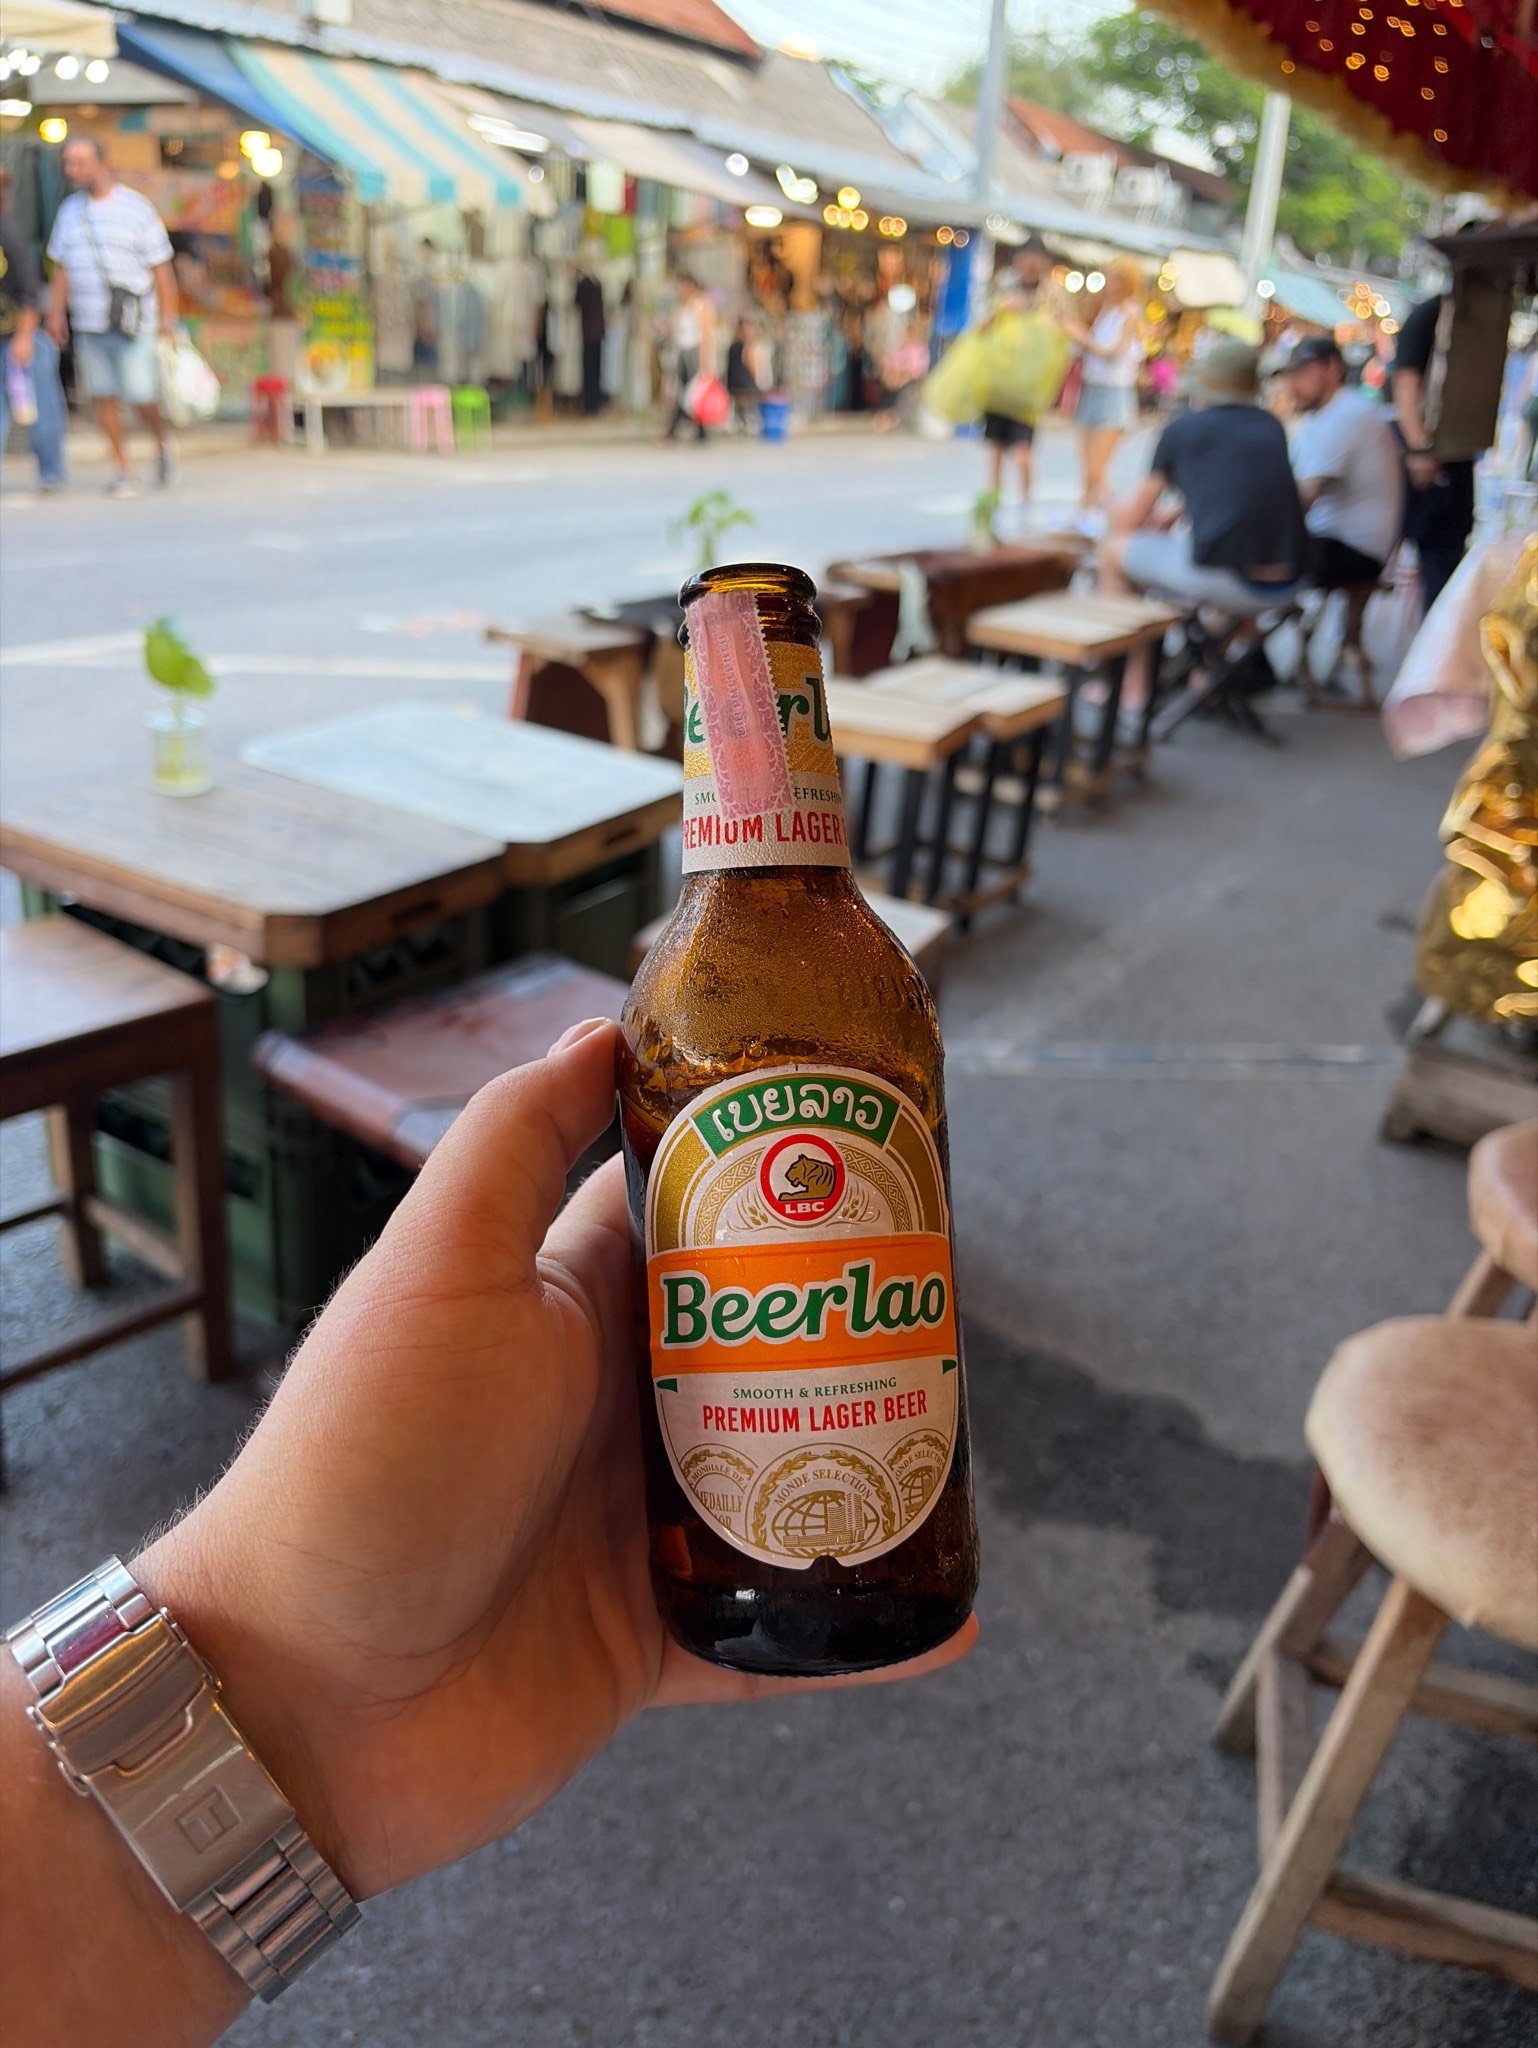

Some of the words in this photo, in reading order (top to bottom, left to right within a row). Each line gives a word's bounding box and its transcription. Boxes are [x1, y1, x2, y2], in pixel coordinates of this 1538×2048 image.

[683, 814, 763, 849] REMIUM
[775, 811, 842, 845] LAGER
[712, 1083, 883, 1142] ເບຍລາວ
[785, 1202, 825, 1214] LBC
[661, 1262, 945, 1346] Beerlao
[733, 1388, 794, 1399] SMOOTH
[799, 1387, 809, 1398] &
[814, 1376, 897, 1397] REFRESHING
[703, 1404, 800, 1433] PREMIUM
[809, 1400, 877, 1432] LAGER
[884, 1389, 928, 1422] BEER
[691, 1464, 731, 1481] MONDIALE
[895, 1455, 914, 1480] ONDE
[774, 1473, 811, 1507] MONDE
[812, 1469, 874, 1500] SELECTION
